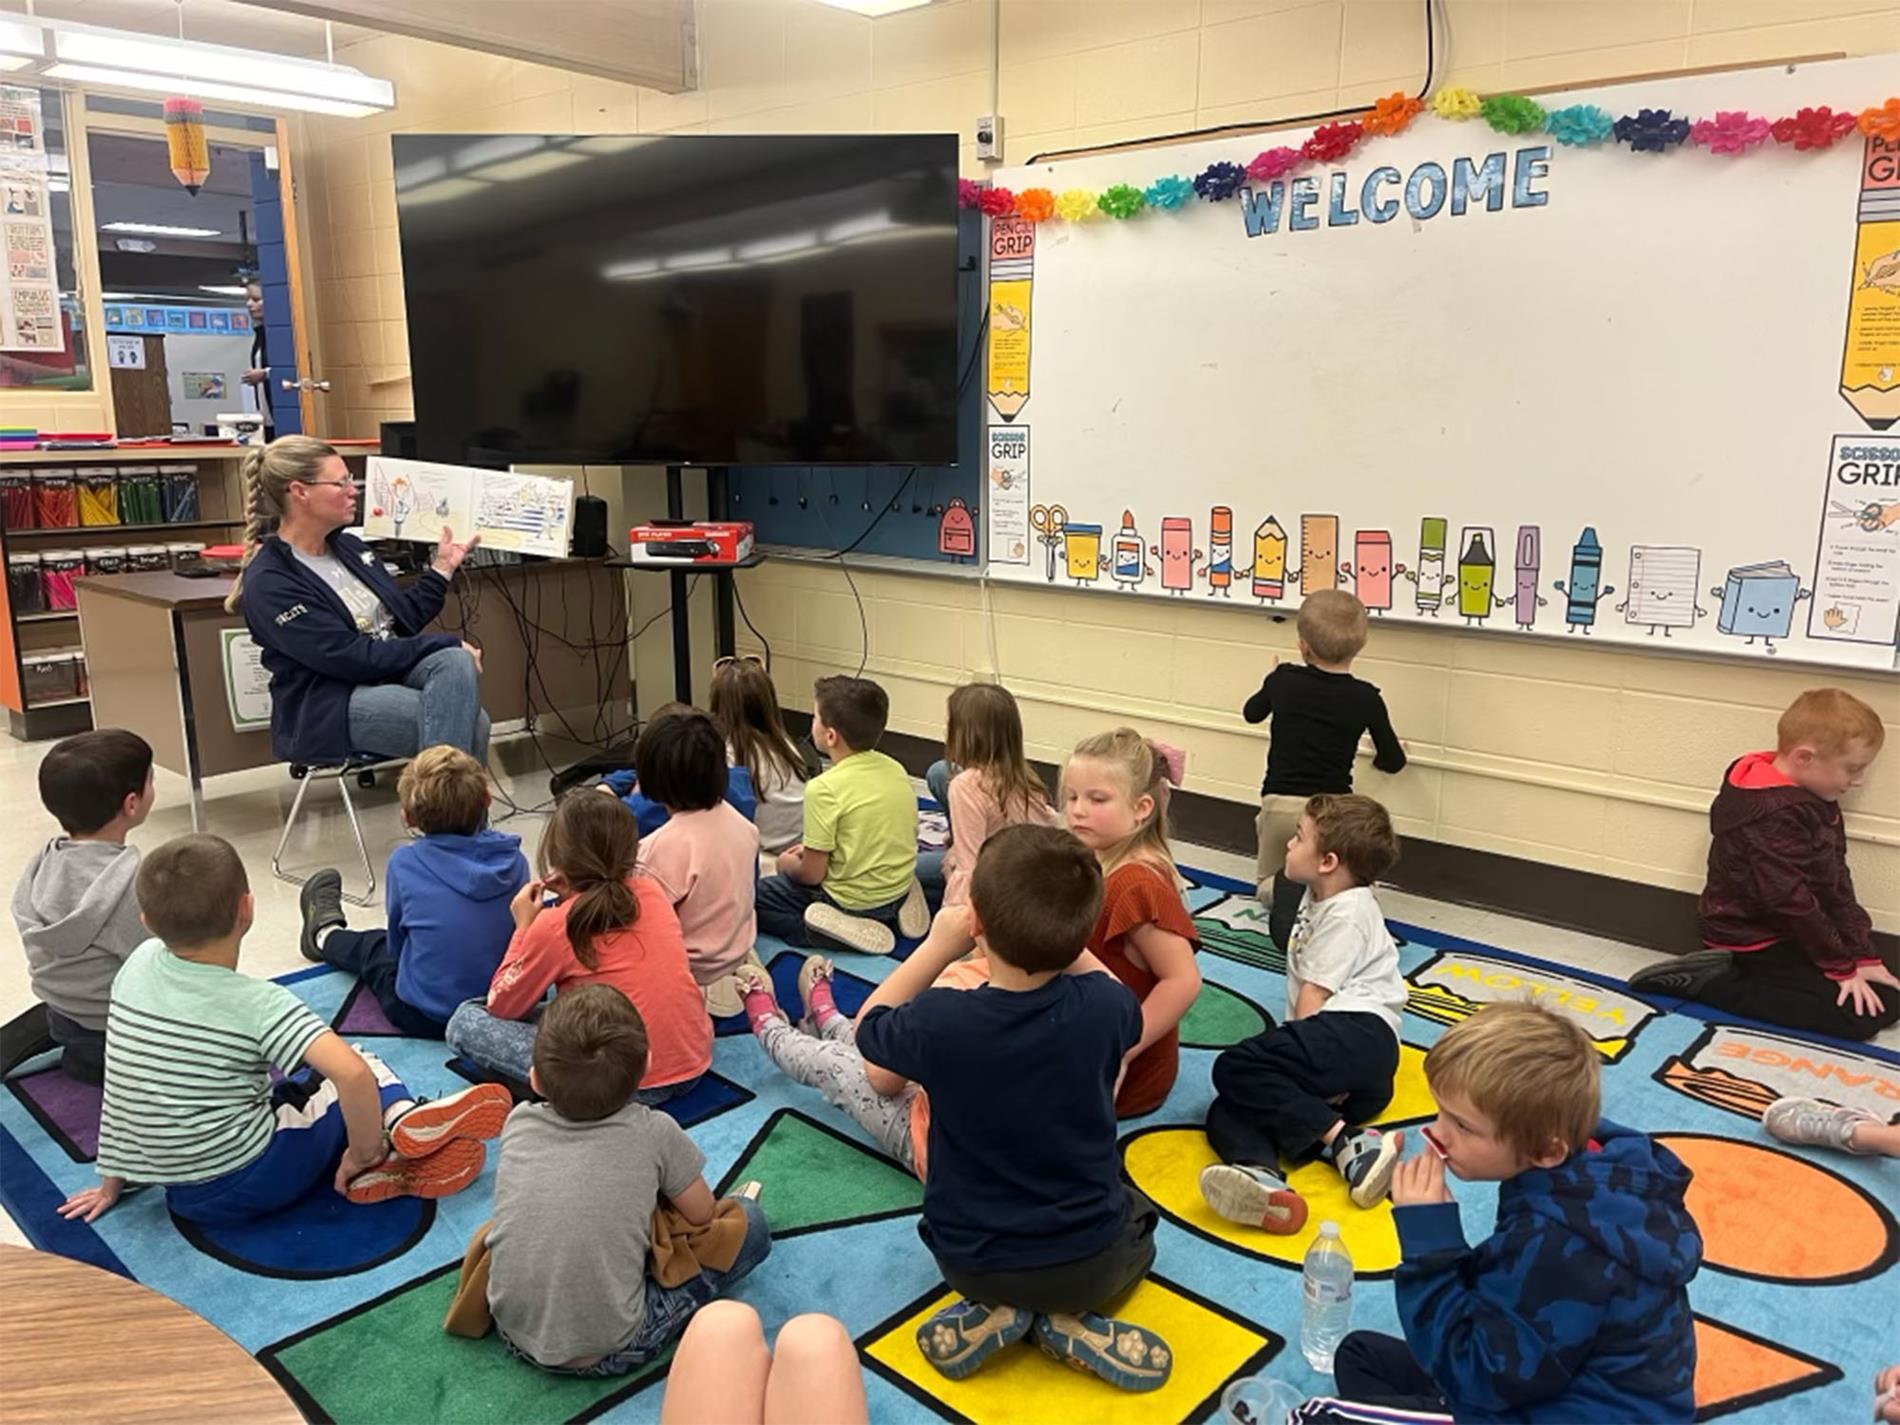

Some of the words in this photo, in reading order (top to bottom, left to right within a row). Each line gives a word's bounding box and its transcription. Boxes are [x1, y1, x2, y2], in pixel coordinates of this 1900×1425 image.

[1238, 146, 1552, 238] WELCOME
[994, 221, 1032, 236] PENCIL
[993, 234, 1033, 255] GRIP
[991, 443, 1027, 459] GRIP
[1433, 962, 1626, 1026] YELLOW
